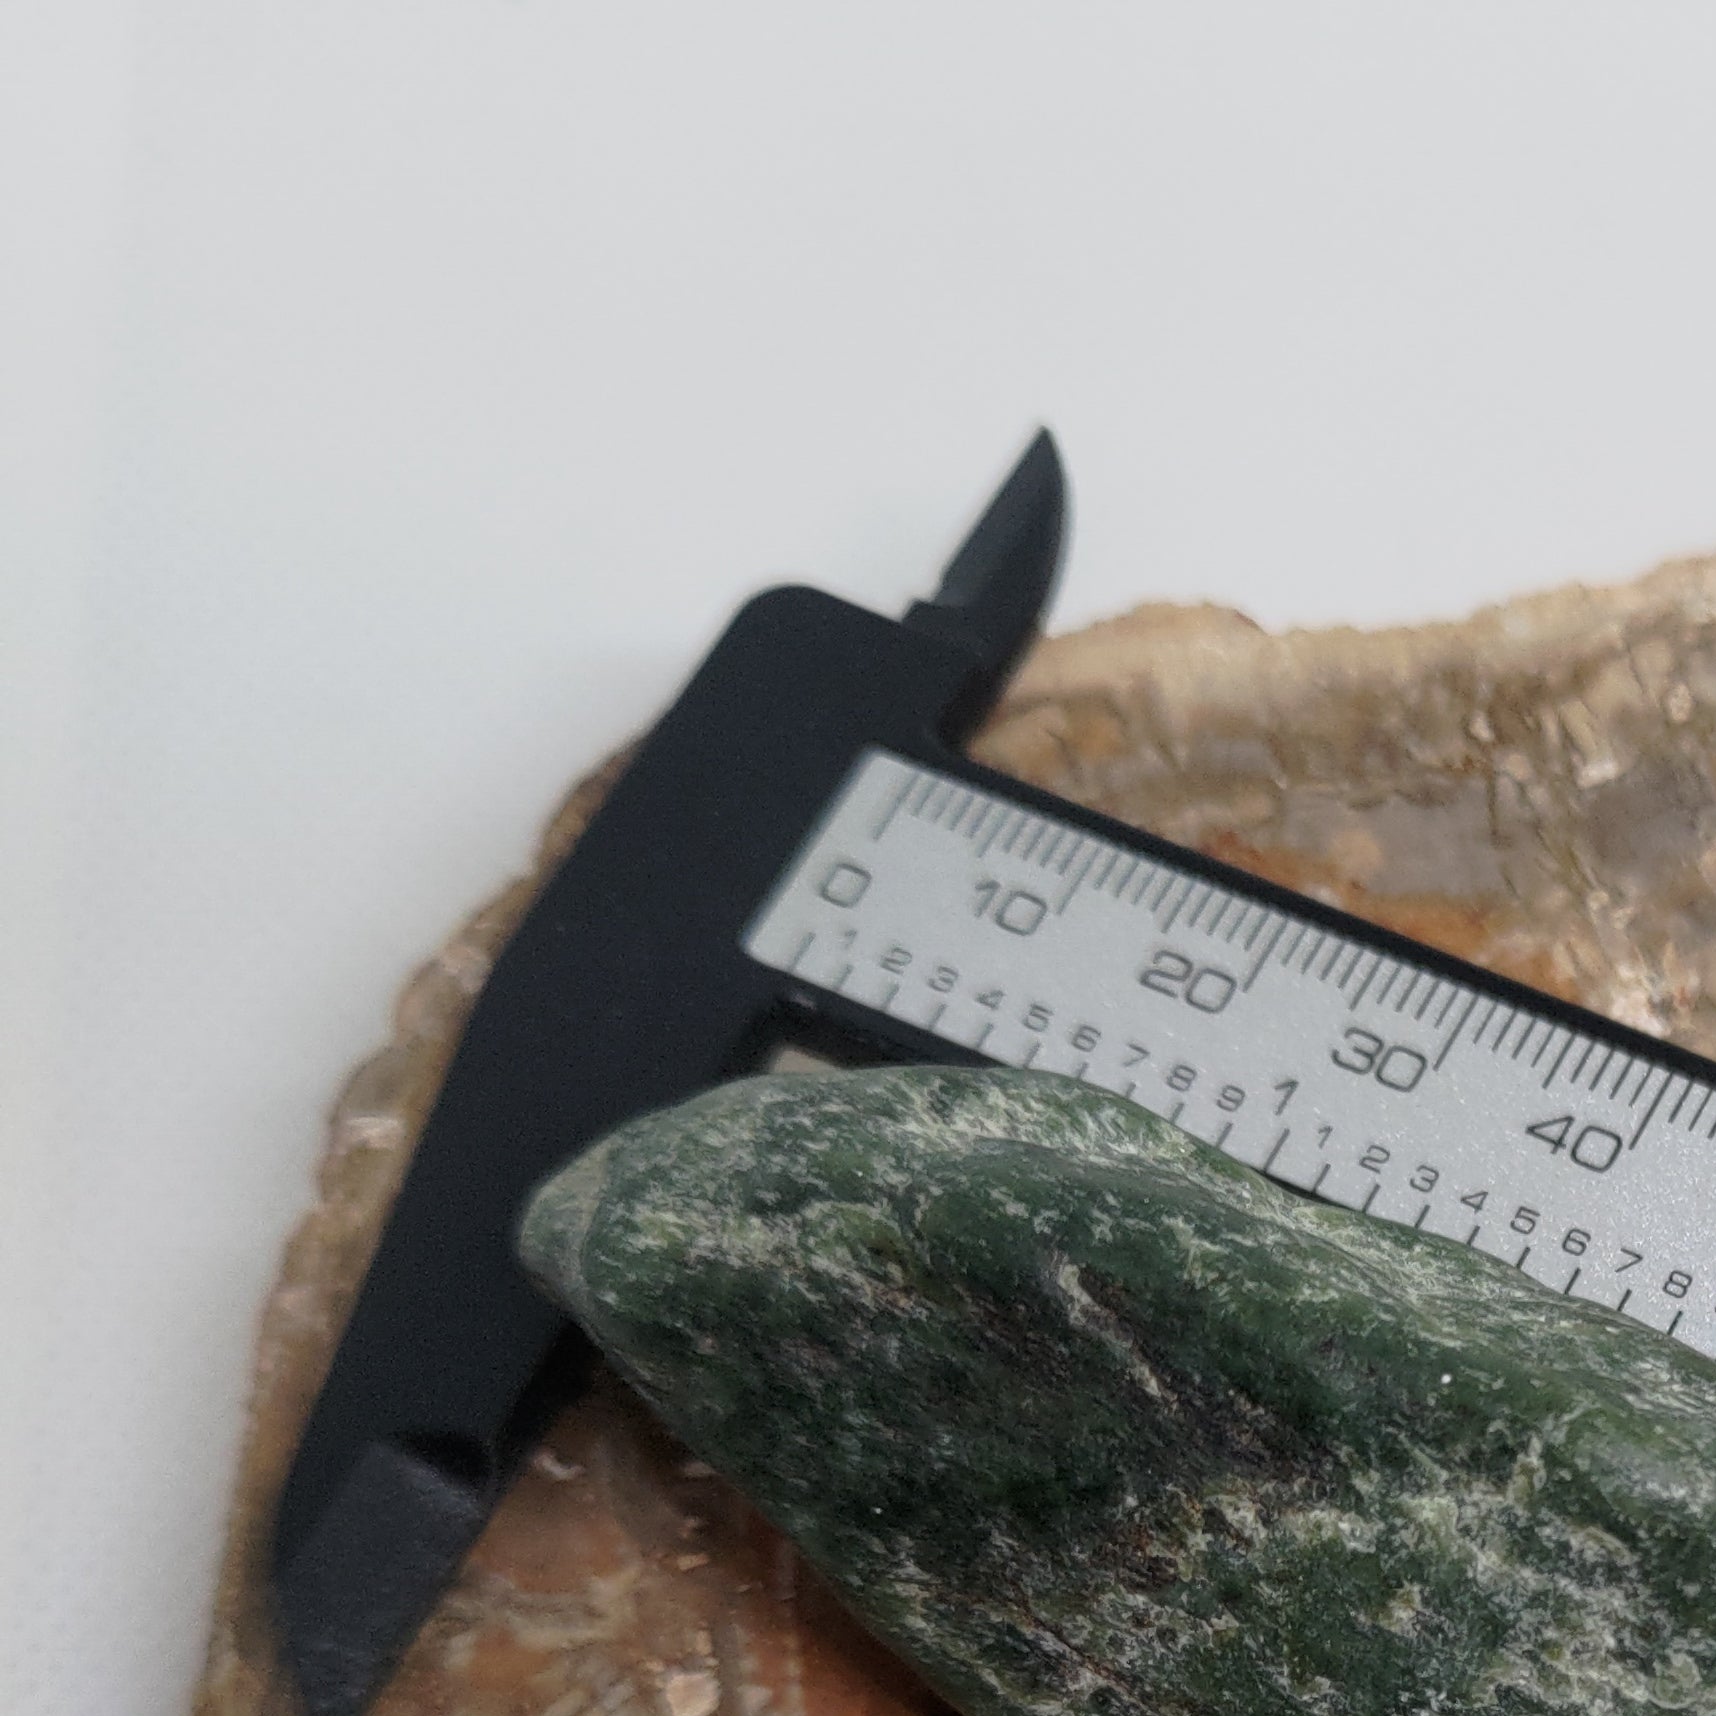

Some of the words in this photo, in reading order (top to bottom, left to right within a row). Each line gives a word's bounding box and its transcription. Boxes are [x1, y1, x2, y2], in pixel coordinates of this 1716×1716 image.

[818, 862, 872, 908] 0
[973, 880, 1047, 936] 10
[1138, 950, 1237, 1014] 20
[1331, 1026, 1427, 1092] 30
[1525, 1115, 1623, 1173] 40
[843, 929, 857, 951] 1
[880, 947, 913, 974] 2
[928, 966, 959, 993] 3
[975, 988, 1005, 1011] 4
[1023, 1005, 1054, 1032] 5
[1070, 1025, 1101, 1052] 6
[1122, 1043, 1150, 1069] 7
[1166, 1065, 1197, 1092] 8
[1216, 1085, 1246, 1112] 9
[1274, 1079, 1300, 1116] 1
[1317, 1125, 1334, 1149] 1
[1359, 1144, 1390, 1173] 2
[1410, 1165, 1440, 1193] 3
[1460, 1189, 1489, 1213] 4
[1510, 1206, 1541, 1235] 5
[1562, 1228, 1592, 1256] 6
[1615, 1248, 1643, 1274] 7
[1662, 1270, 1693, 1299] 8
